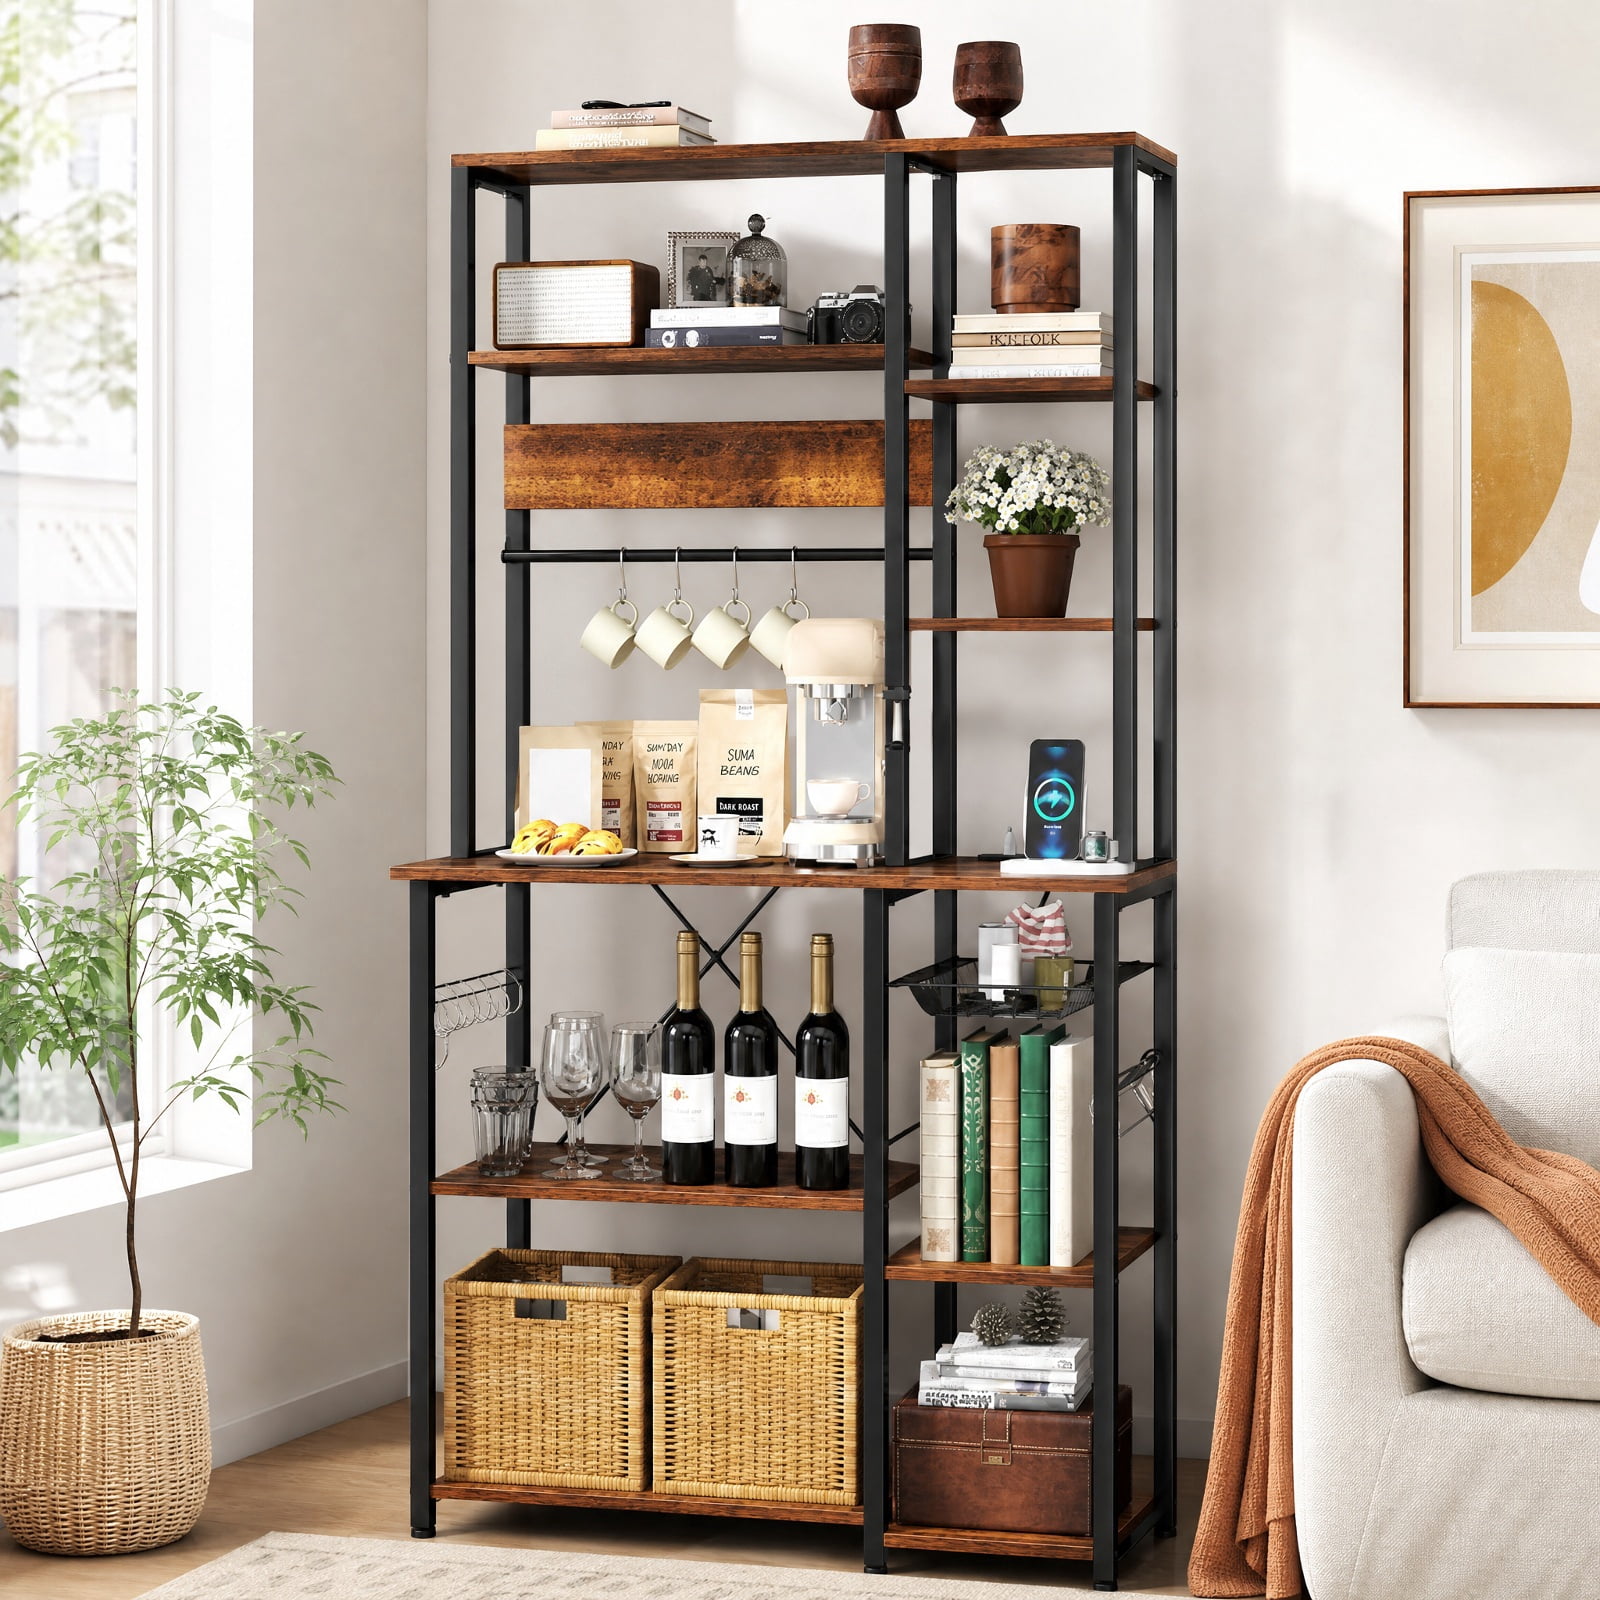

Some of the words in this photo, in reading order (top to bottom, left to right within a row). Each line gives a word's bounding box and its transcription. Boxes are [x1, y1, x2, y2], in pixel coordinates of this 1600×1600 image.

[727, 748, 755, 762] SUMA
[720, 765, 760, 776] BEANS
[719, 802, 736, 811] DARK
[738, 803, 760, 811] ROAST
